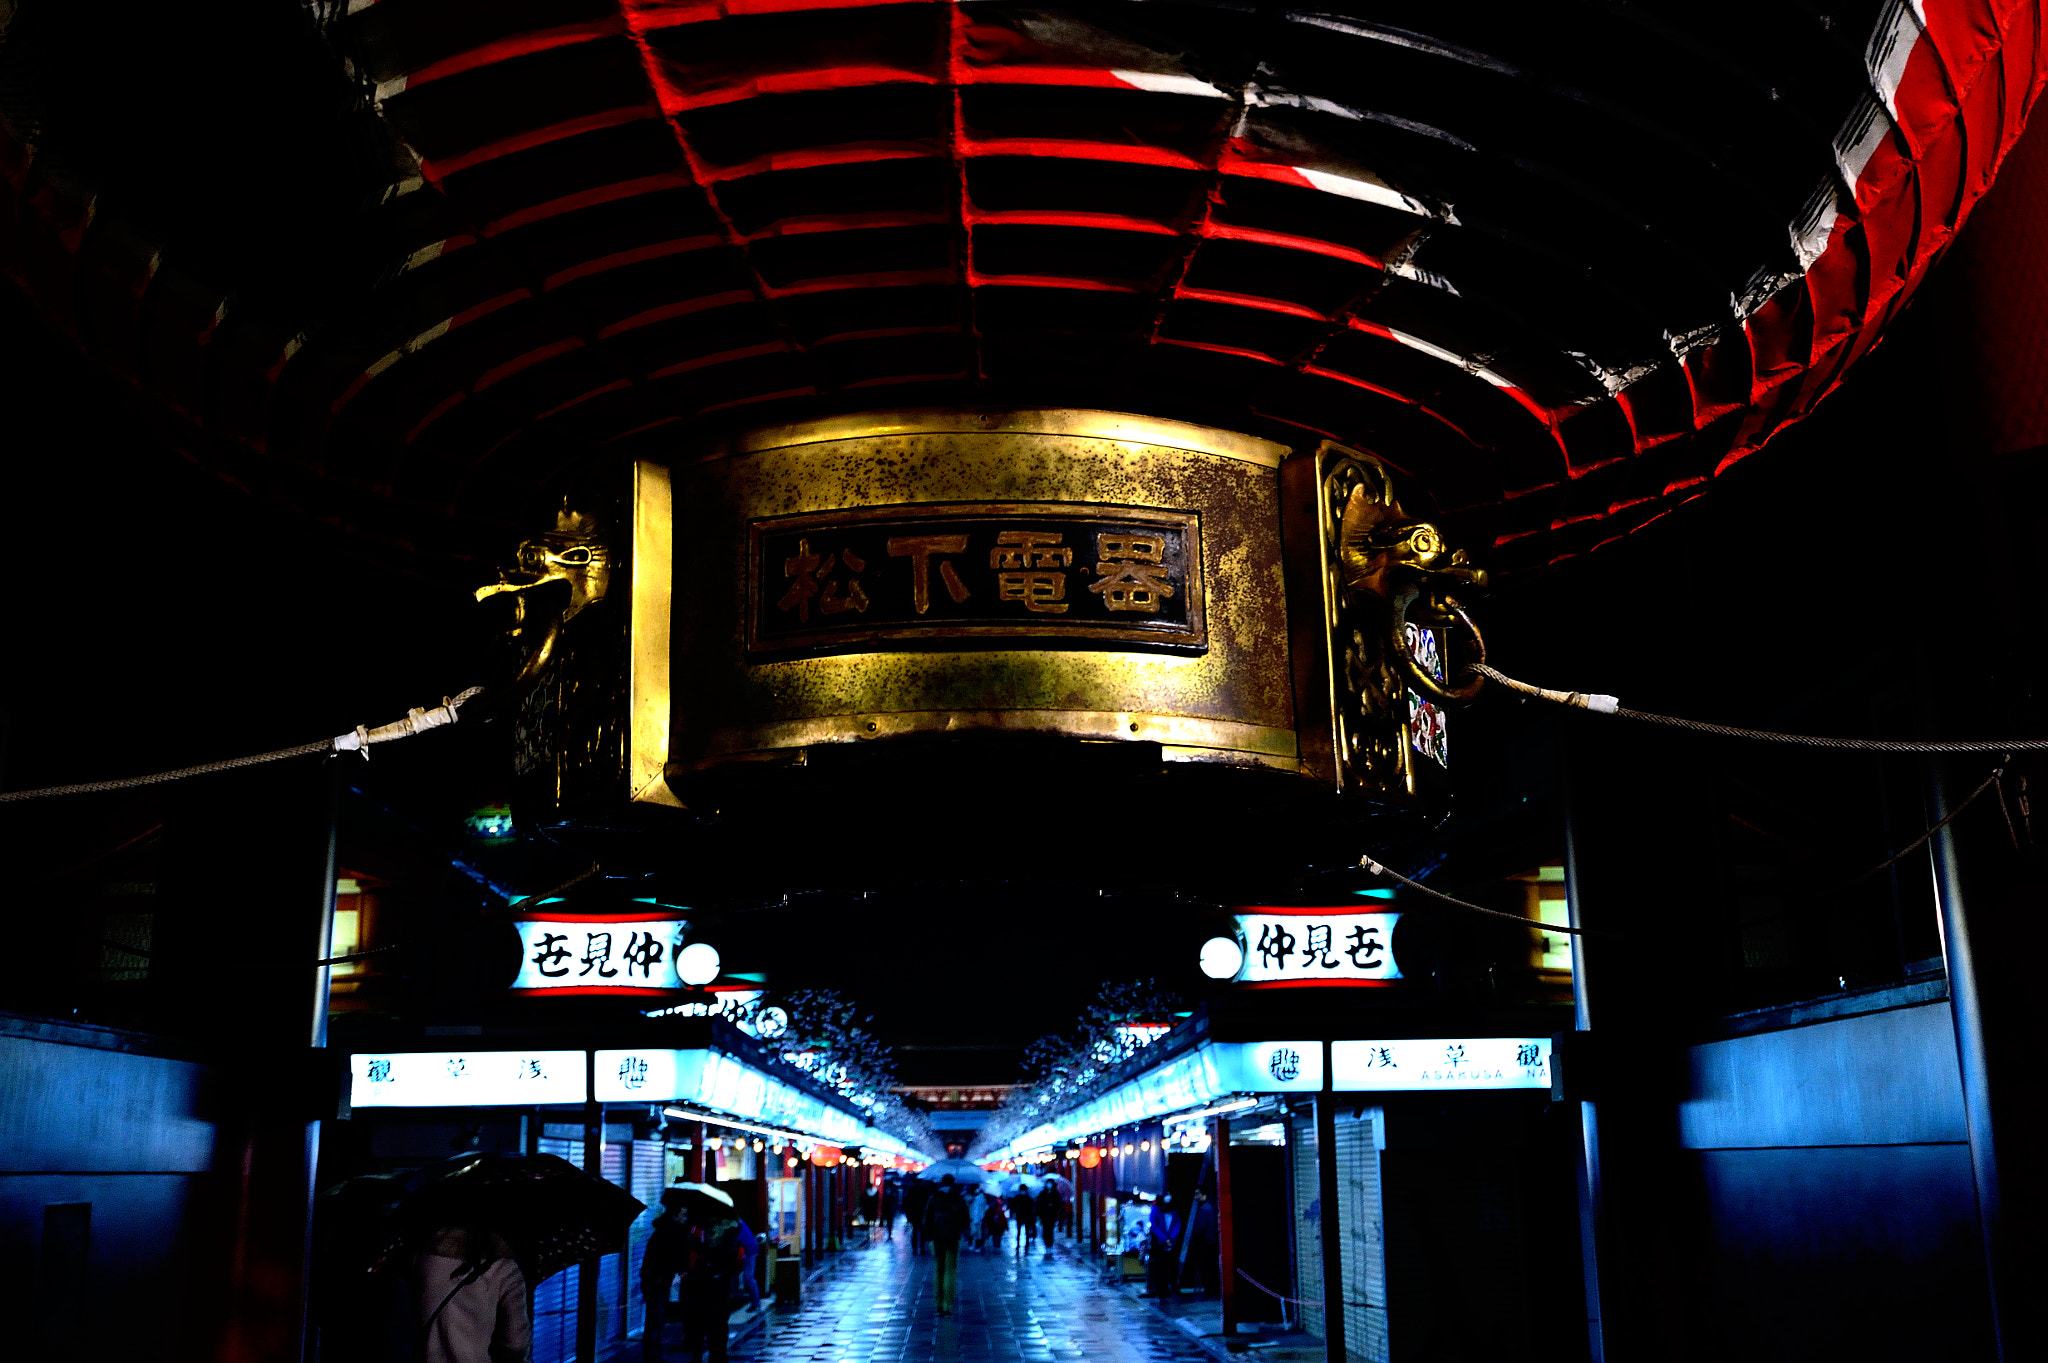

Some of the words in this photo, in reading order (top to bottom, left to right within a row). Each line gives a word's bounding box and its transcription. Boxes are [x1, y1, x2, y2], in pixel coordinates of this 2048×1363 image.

[777, 530, 1175, 622] 松下電器
[1256, 923, 1384, 970] 仲見世
[1421, 1069, 1503, 1080] ASAKUSA
